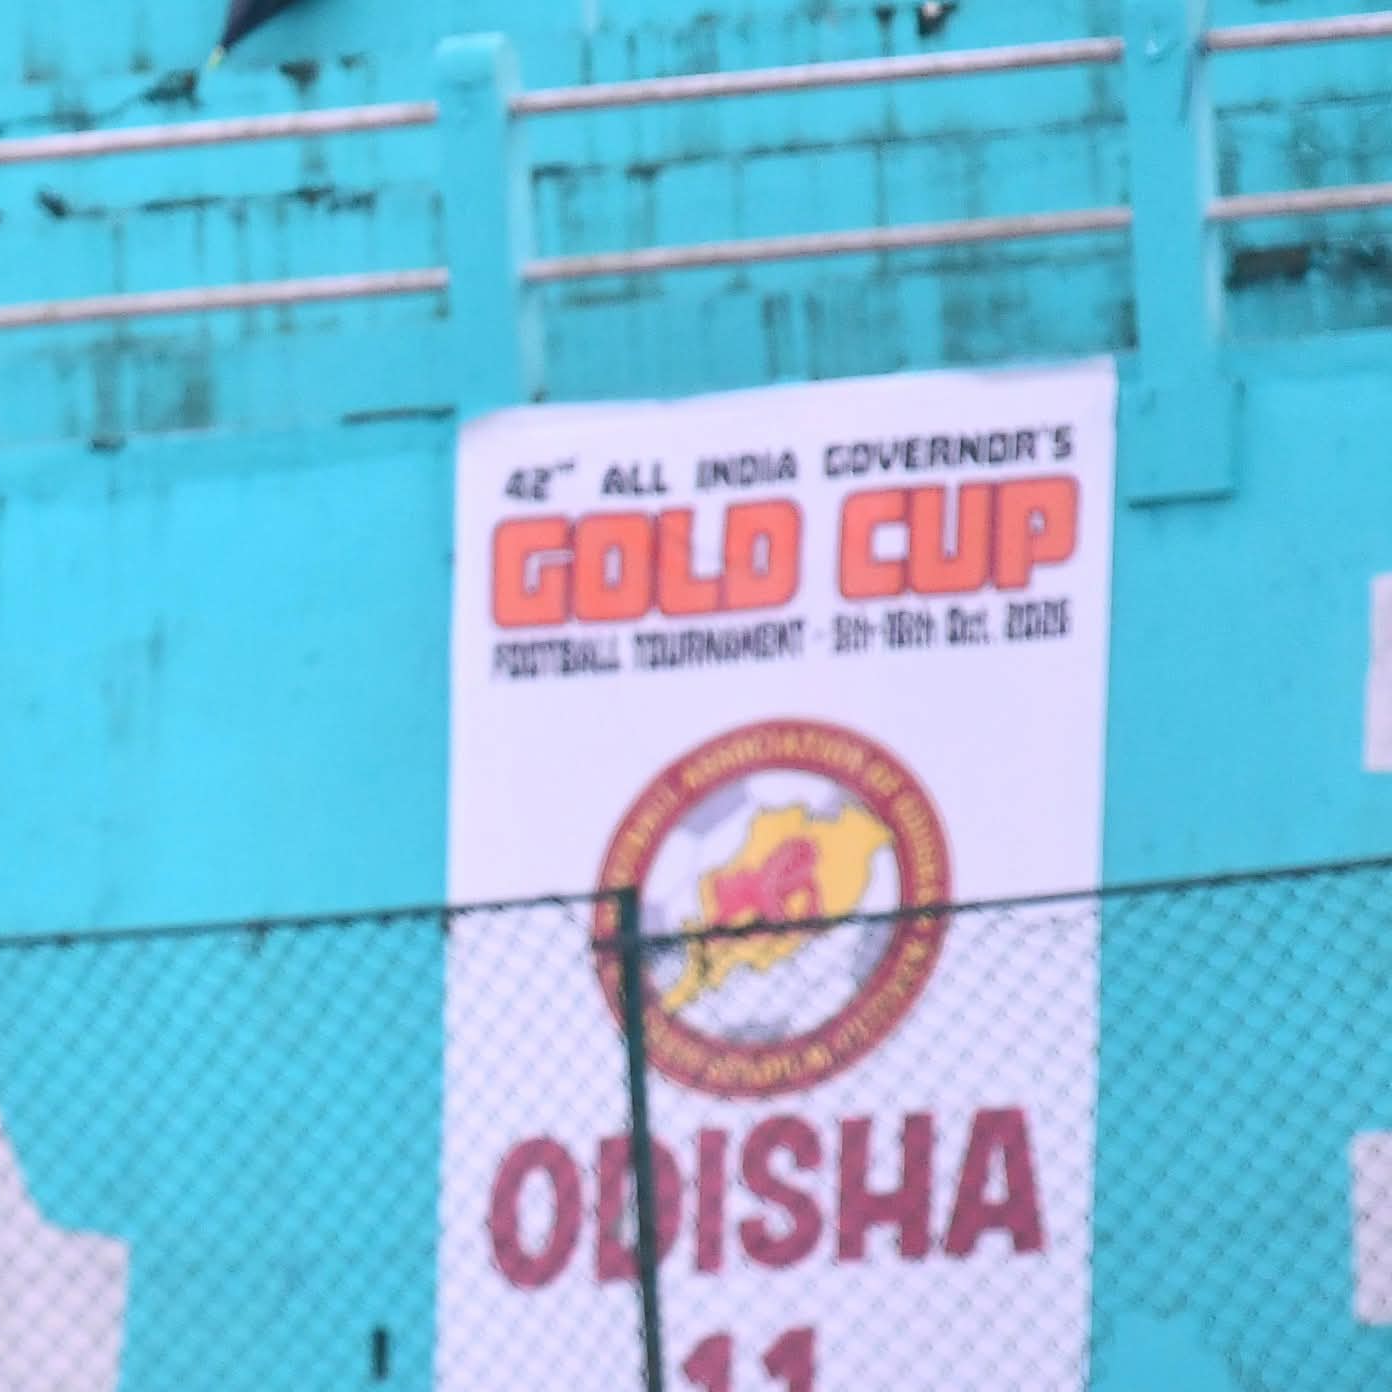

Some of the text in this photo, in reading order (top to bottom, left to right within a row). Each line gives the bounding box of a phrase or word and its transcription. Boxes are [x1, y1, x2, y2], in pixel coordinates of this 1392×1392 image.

[600, 462, 669, 496] ALL
[696, 450, 798, 489] INDIA
[824, 425, 1074, 478] GOVERNOR'S
[492, 474, 1079, 628] GOLD CUP
[632, 616, 805, 670] TOURNAMENT
[488, 1107, 1048, 1290] ODISHA
